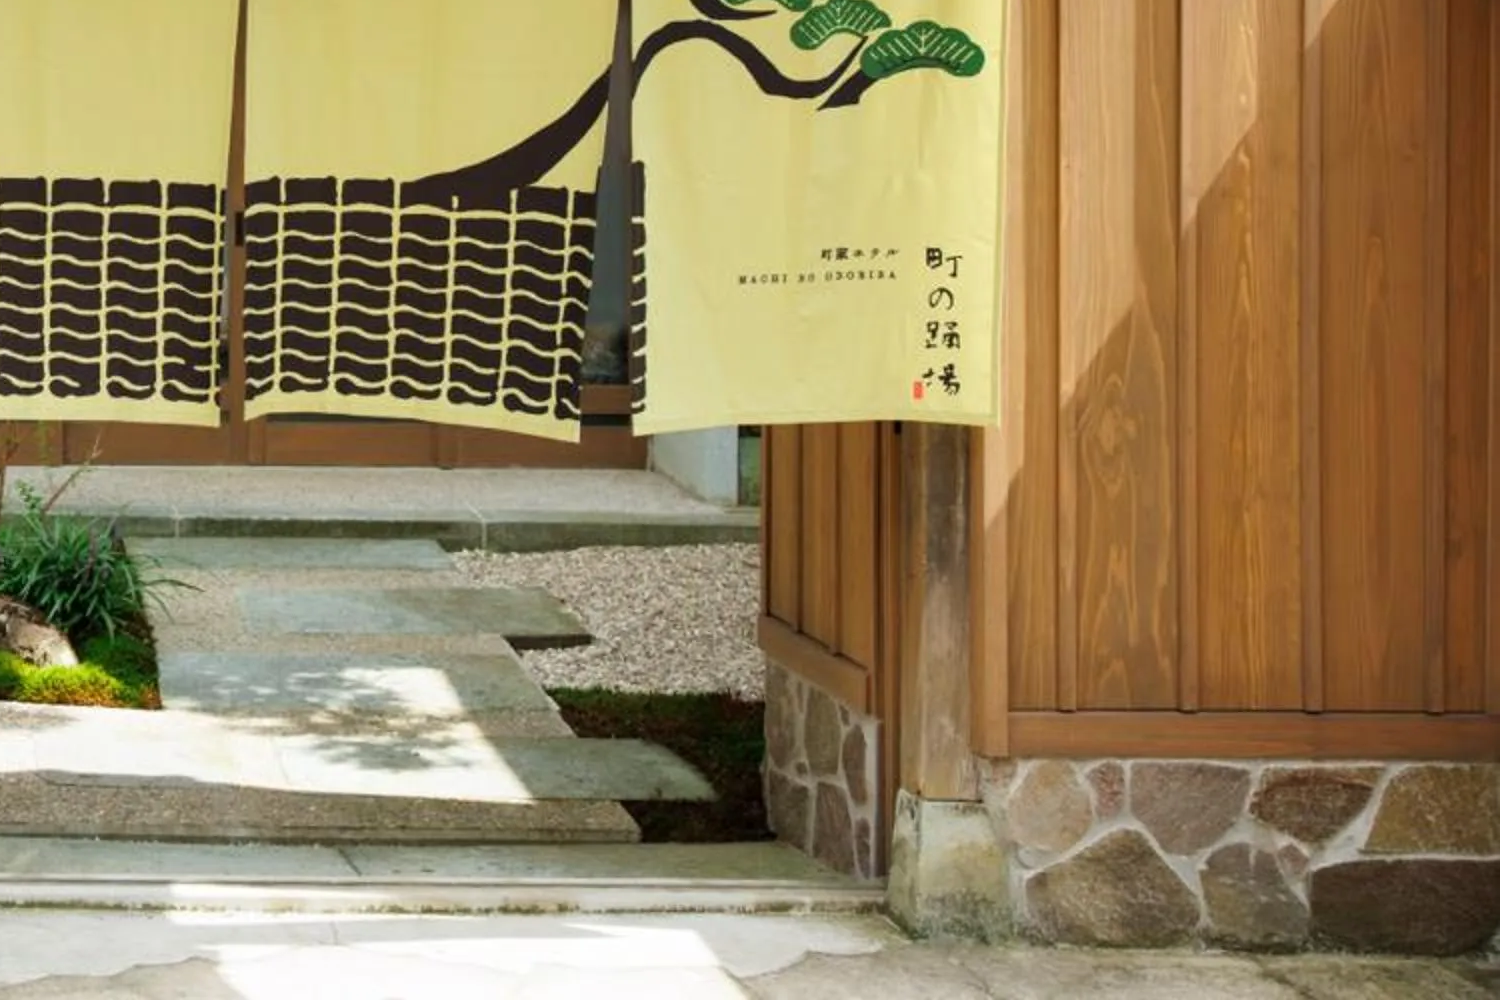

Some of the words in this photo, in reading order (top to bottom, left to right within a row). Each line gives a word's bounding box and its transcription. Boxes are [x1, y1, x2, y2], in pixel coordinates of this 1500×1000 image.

[738, 273, 788, 285] MACHI
[922, 246, 964, 396] 町の踊場
